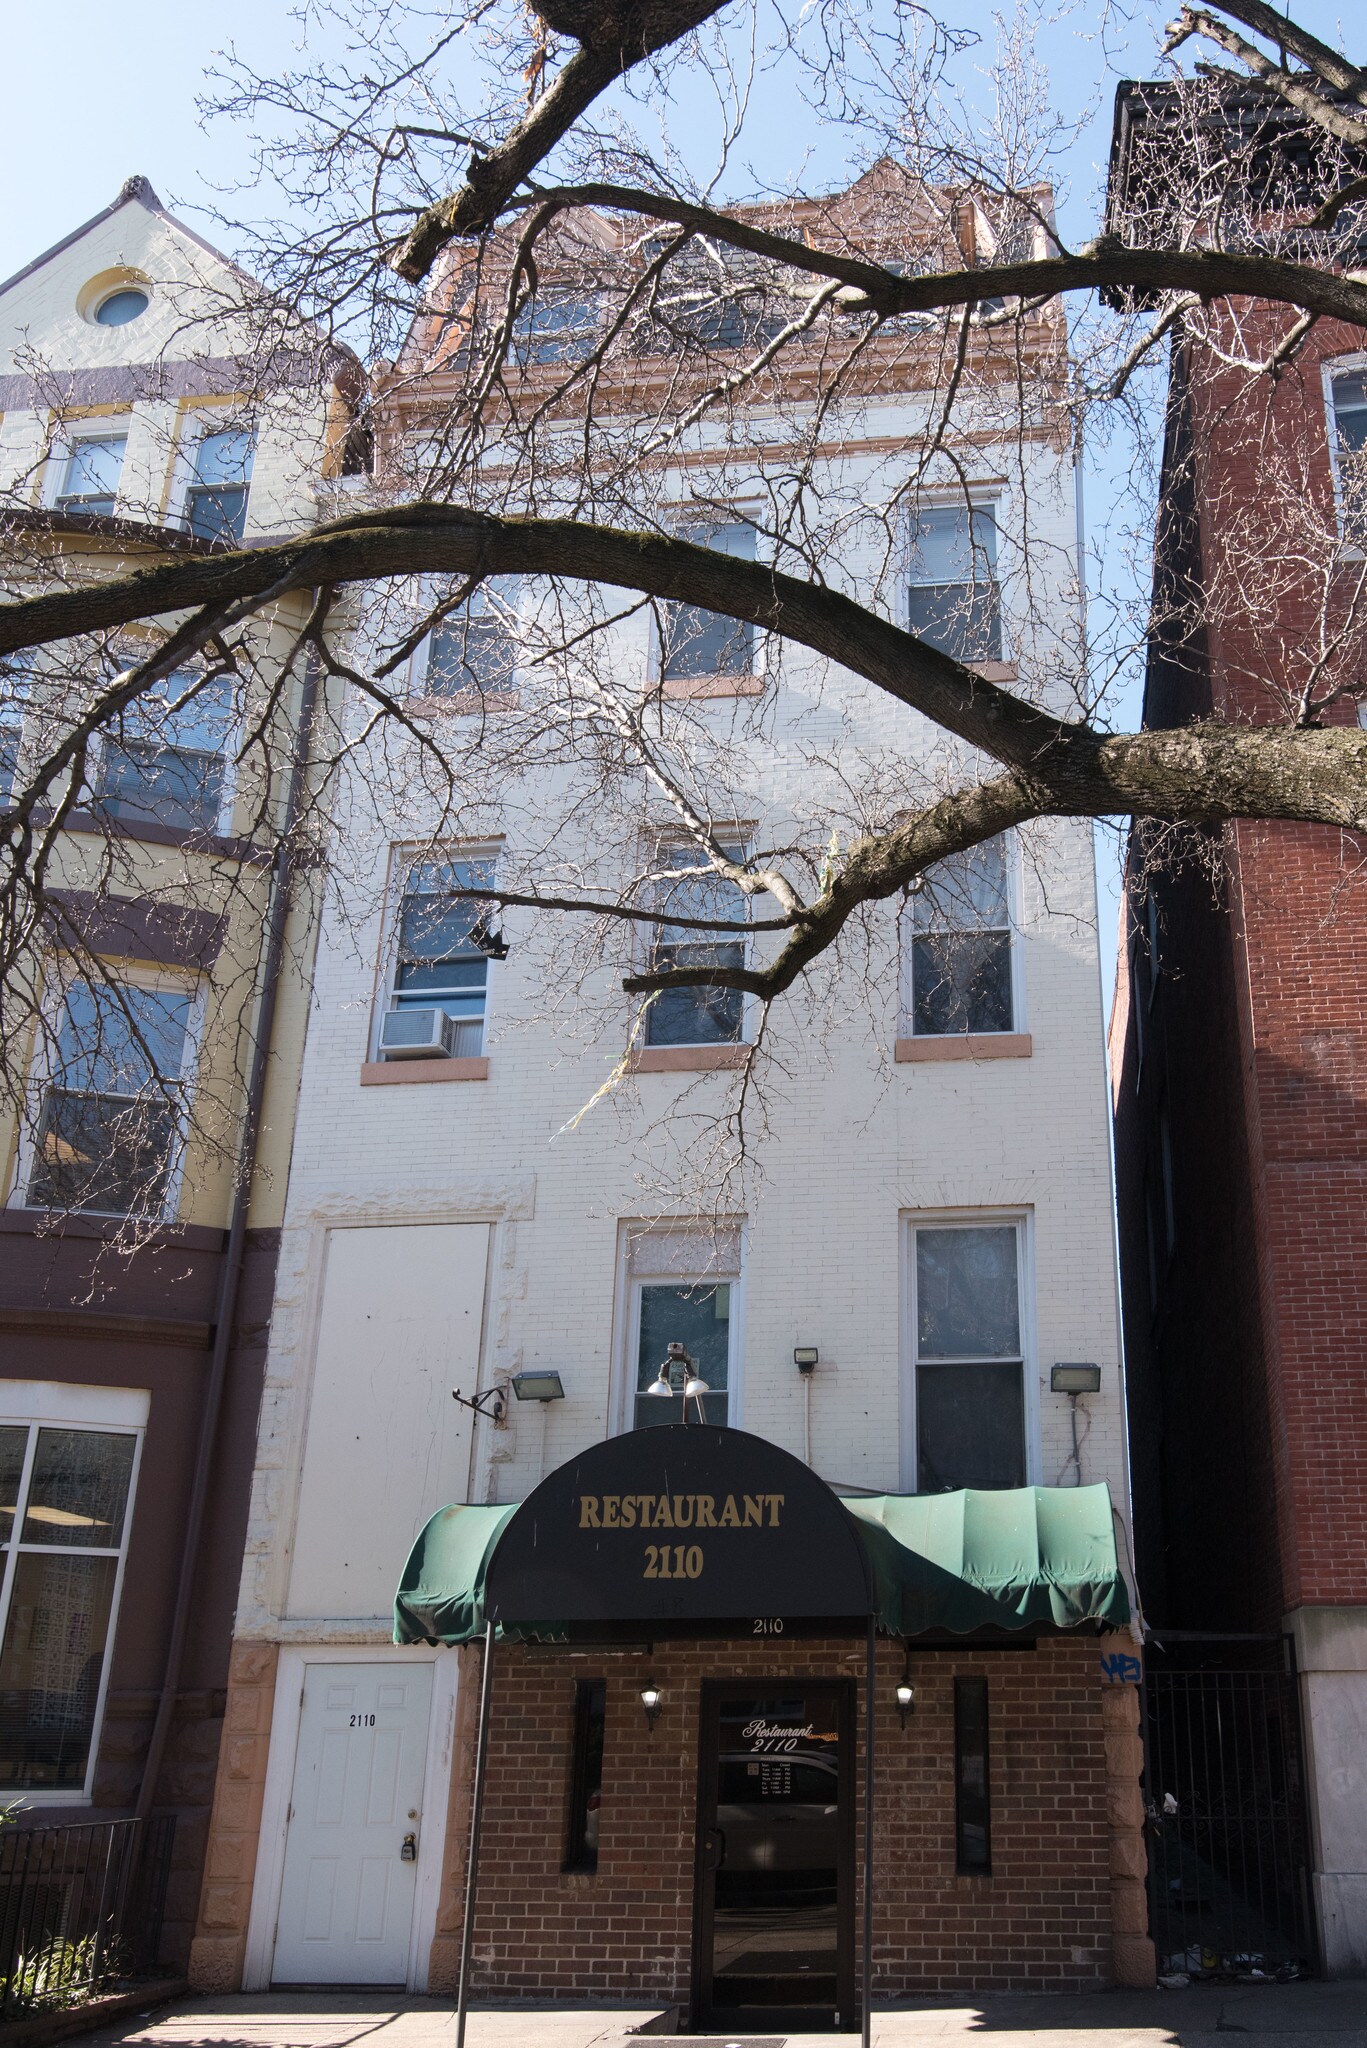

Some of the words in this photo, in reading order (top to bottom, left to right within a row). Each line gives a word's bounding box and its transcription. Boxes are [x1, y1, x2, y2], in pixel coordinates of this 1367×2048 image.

[578, 1494, 785, 1528] RESTAURANT
[642, 1545, 704, 1579] 2110
[752, 1618, 784, 1634] 2110
[349, 1714, 376, 1727] 2110
[742, 1719, 814, 1738] Restaurant
[750, 1738, 798, 1752] 2110
